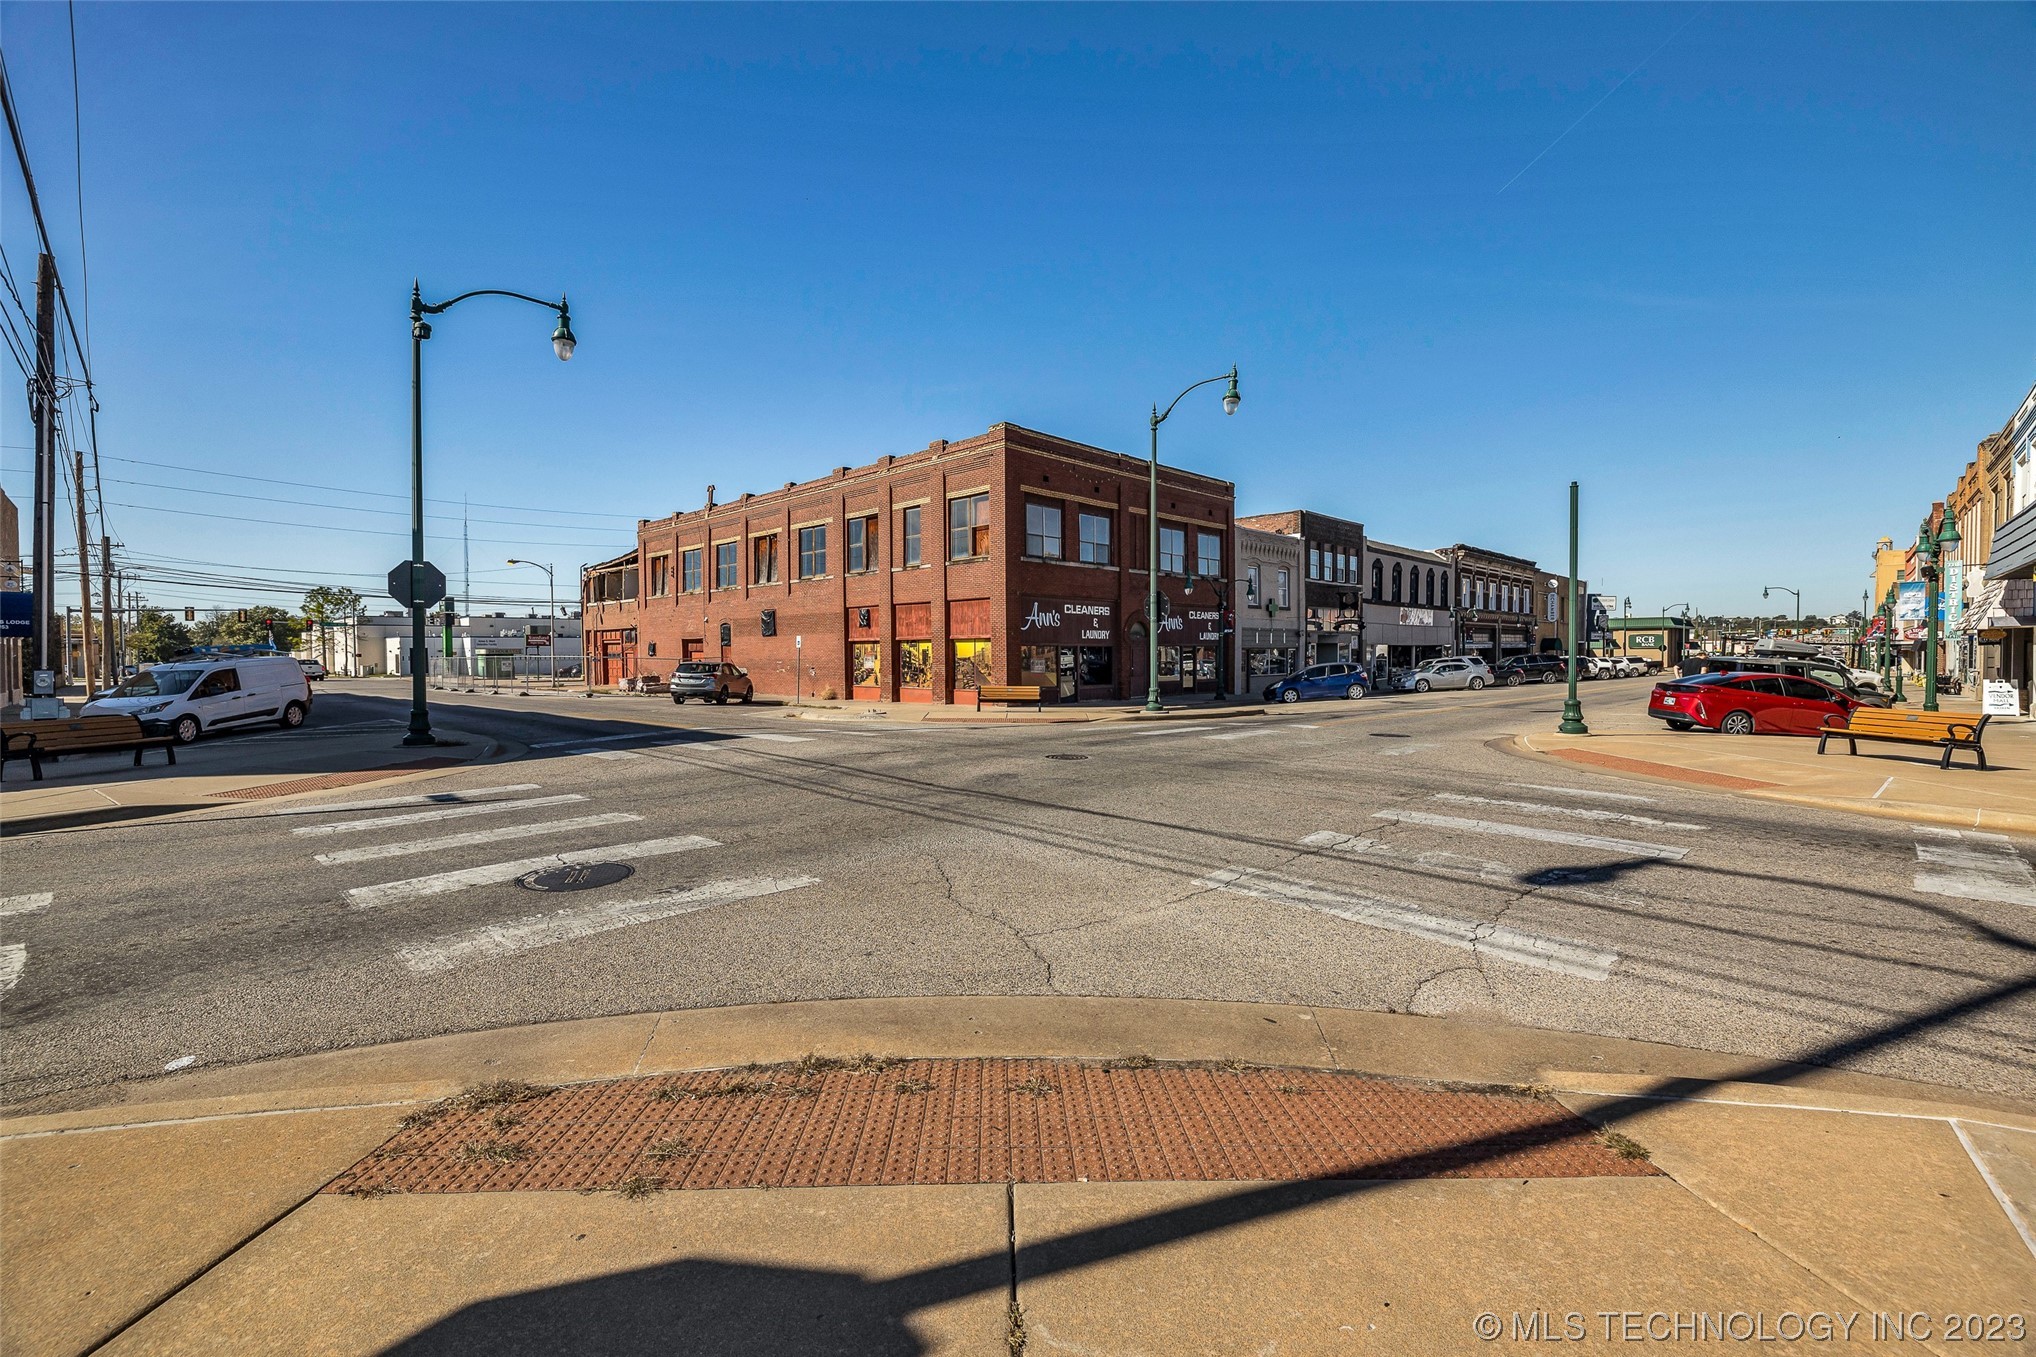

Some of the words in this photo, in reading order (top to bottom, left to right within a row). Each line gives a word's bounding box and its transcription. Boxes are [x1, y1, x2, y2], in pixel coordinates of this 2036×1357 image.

[1948, 568, 1960, 630] DISTRICT
[1021, 602, 1060, 630] Ann's
[1064, 604, 1110, 615] CLEANERS
[1093, 618, 1099, 628] &
[1157, 615, 1183, 633] Ann's
[1188, 611, 1219, 620] CLEANERS
[1081, 630, 1110, 639] LAUNDRY
